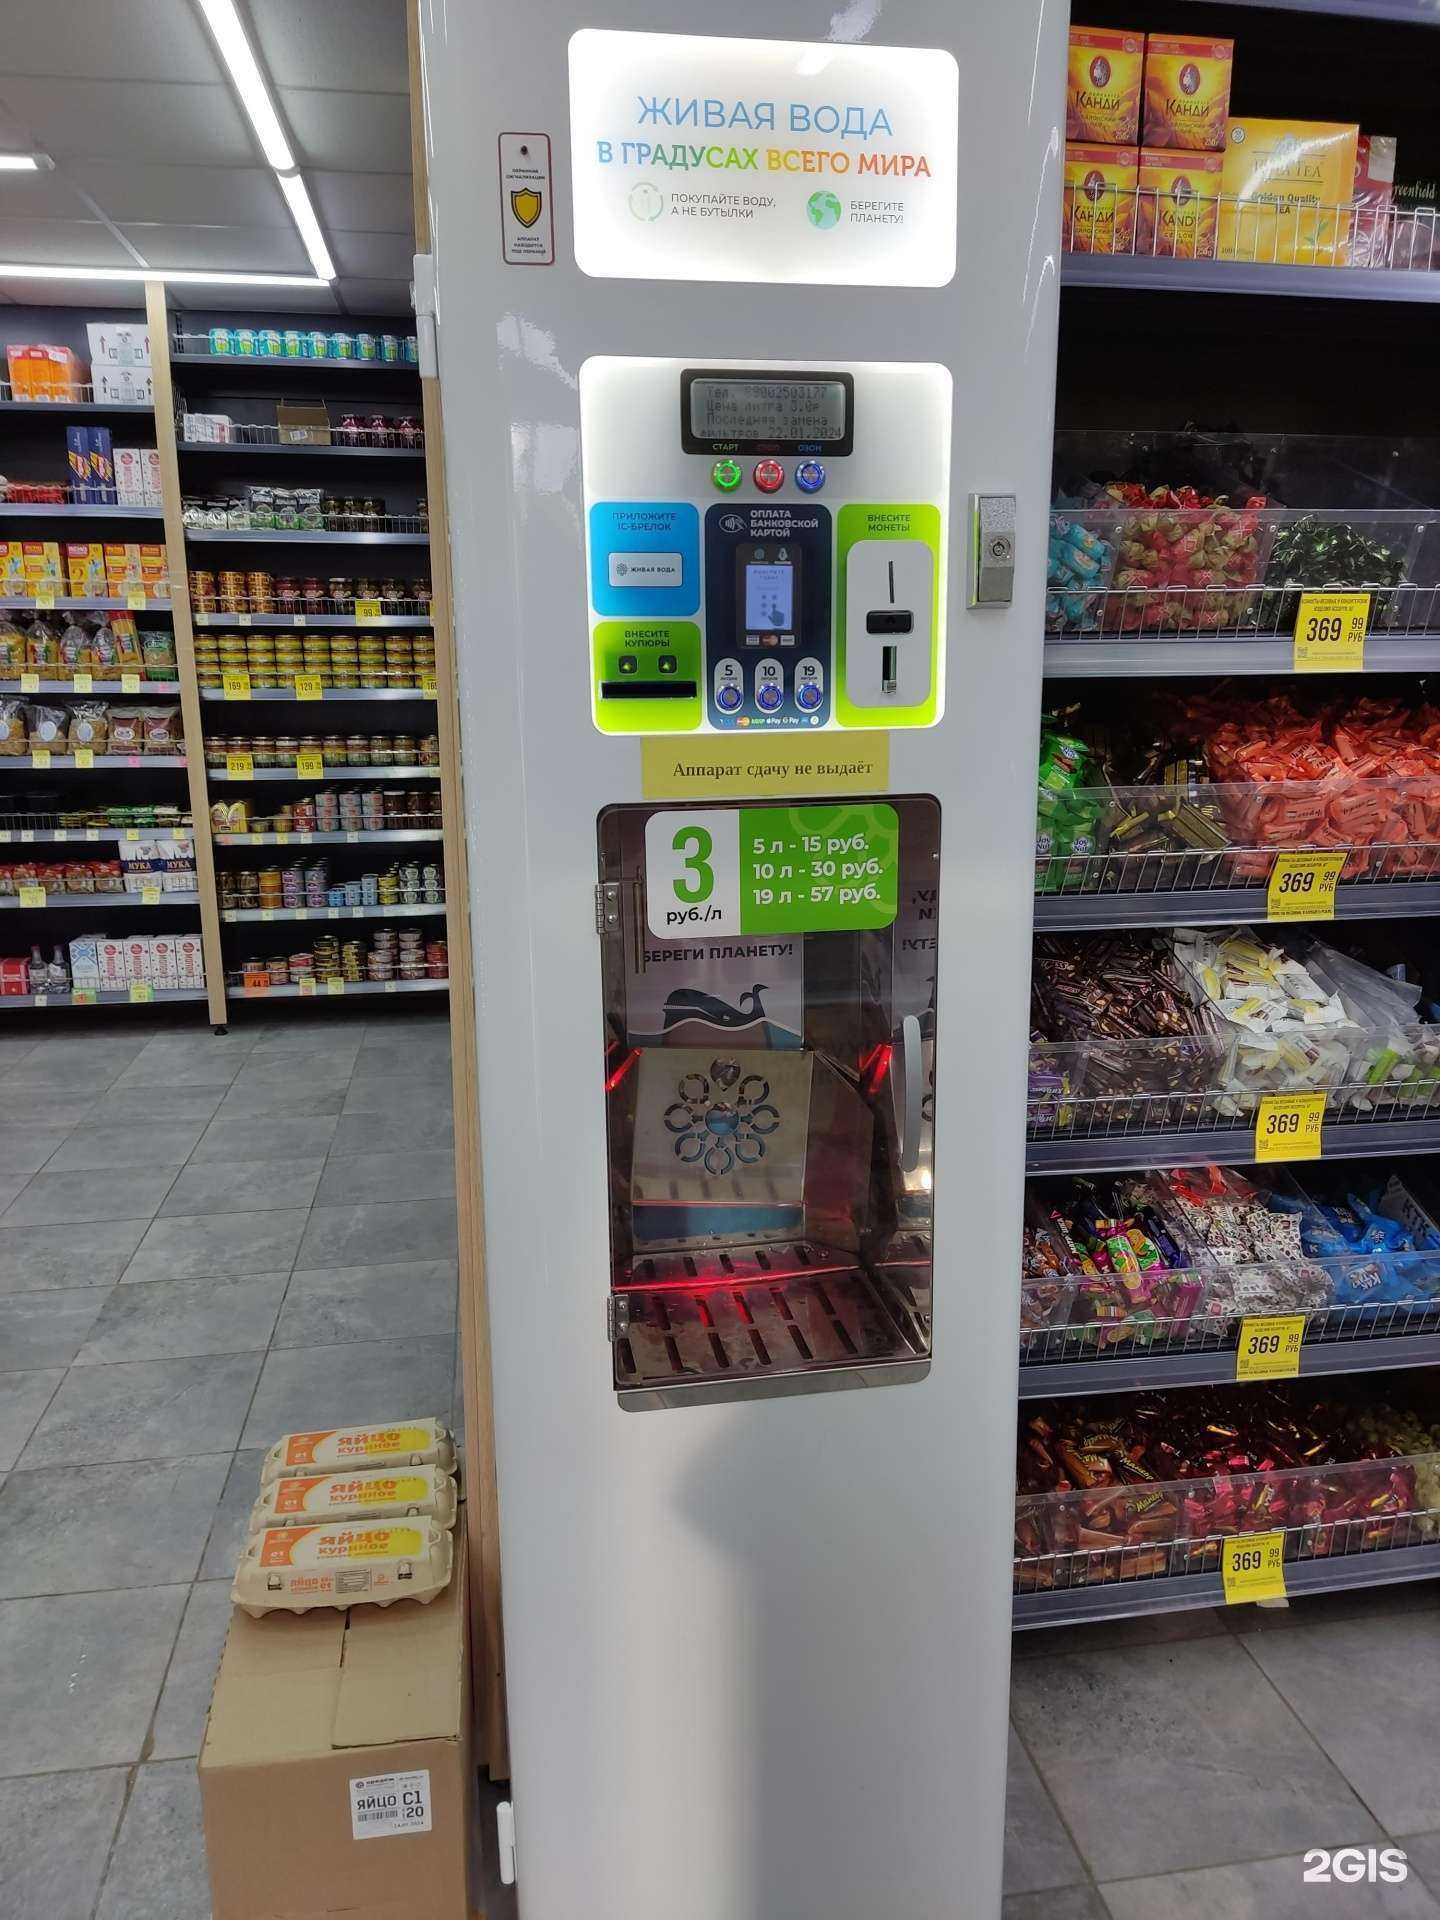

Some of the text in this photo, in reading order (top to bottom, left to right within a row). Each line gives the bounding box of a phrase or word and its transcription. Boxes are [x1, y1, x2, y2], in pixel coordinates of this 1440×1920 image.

[637, 95, 893, 139] ЖИВАЯ ВОДА
[596, 141, 932, 178] В ГРАДУСАХ ВСЕГО МИРА
[671, 192, 777, 208] ПОКУПАЙТЕ ВОДУ,
[850, 200, 904, 212] БЕРЕГИТЕ
[671, 207, 754, 218] А НЕ БУТЫЛКИ
[850, 212, 904, 224] ПЛАНЕТУ!
[712, 443, 739, 451] СТАРТ
[612, 512, 678, 520] ПРИЛОЖИТЕ
[750, 509, 792, 519] ОПЛАТА
[867, 514, 911, 523] ВНЕСИТЕ
[750, 518, 819, 529] БАНКОВСКОЙ
[867, 523, 910, 532] МОНЕТЫ
[750, 527, 790, 537] КАРТОЙ
[1351, 617, 1364, 629] 99
[625, 630, 670, 638] ВНЕСИТЕ
[1306, 617, 1342, 641] 369
[1347, 632, 1363, 643] РУБ
[625, 639, 670, 648] КУПЮРЫ
[725, 664, 734, 676] 5
[763, 666, 776, 676] 10
[803, 665, 816, 676] 19
[673, 761, 874, 780] Аппарат сдачу не выдаёт
[753, 839, 765, 854] 5
[769, 841, 783, 854] л
[801, 836, 822, 853] 15
[827, 833, 870, 855] руб.
[128, 862, 152, 870] МУКА
[167, 860, 191, 869] МУКА
[672, 825, 714, 904] 3
[753, 864, 774, 880] 10
[779, 865, 793, 879] л
[811, 861, 836, 878] 30
[841, 858, 884, 880] руб.
[1323, 871, 1336, 881] 99
[1279, 872, 1315, 893] 369
[1319, 882, 1334, 892] РУБ
[753, 889, 774, 905] 19
[778, 890, 792, 904] л
[810, 886, 834, 903] 57
[838, 883, 881, 906] руб.
[666, 905, 722, 926] руб./л
[709, 944, 793, 960] ПЛАНЕТУ!
[1308, 1111, 1320, 1122] 99
[1266, 1113, 1300, 1134] 369
[1305, 1124, 1319, 1133] РУБ
[1288, 1333, 1299, 1343] 99
[1248, 1335, 1280, 1355] 369
[1285, 1344, 1299, 1353] РУБ
[1269, 1548, 1280, 1557] 99
[1232, 1551, 1261, 1571] 369
[1267, 1559, 1280, 1568] РУБ
[357, 1791, 422, 1810] ЯЙЦО С1
[406, 1806, 424, 1818] 20
